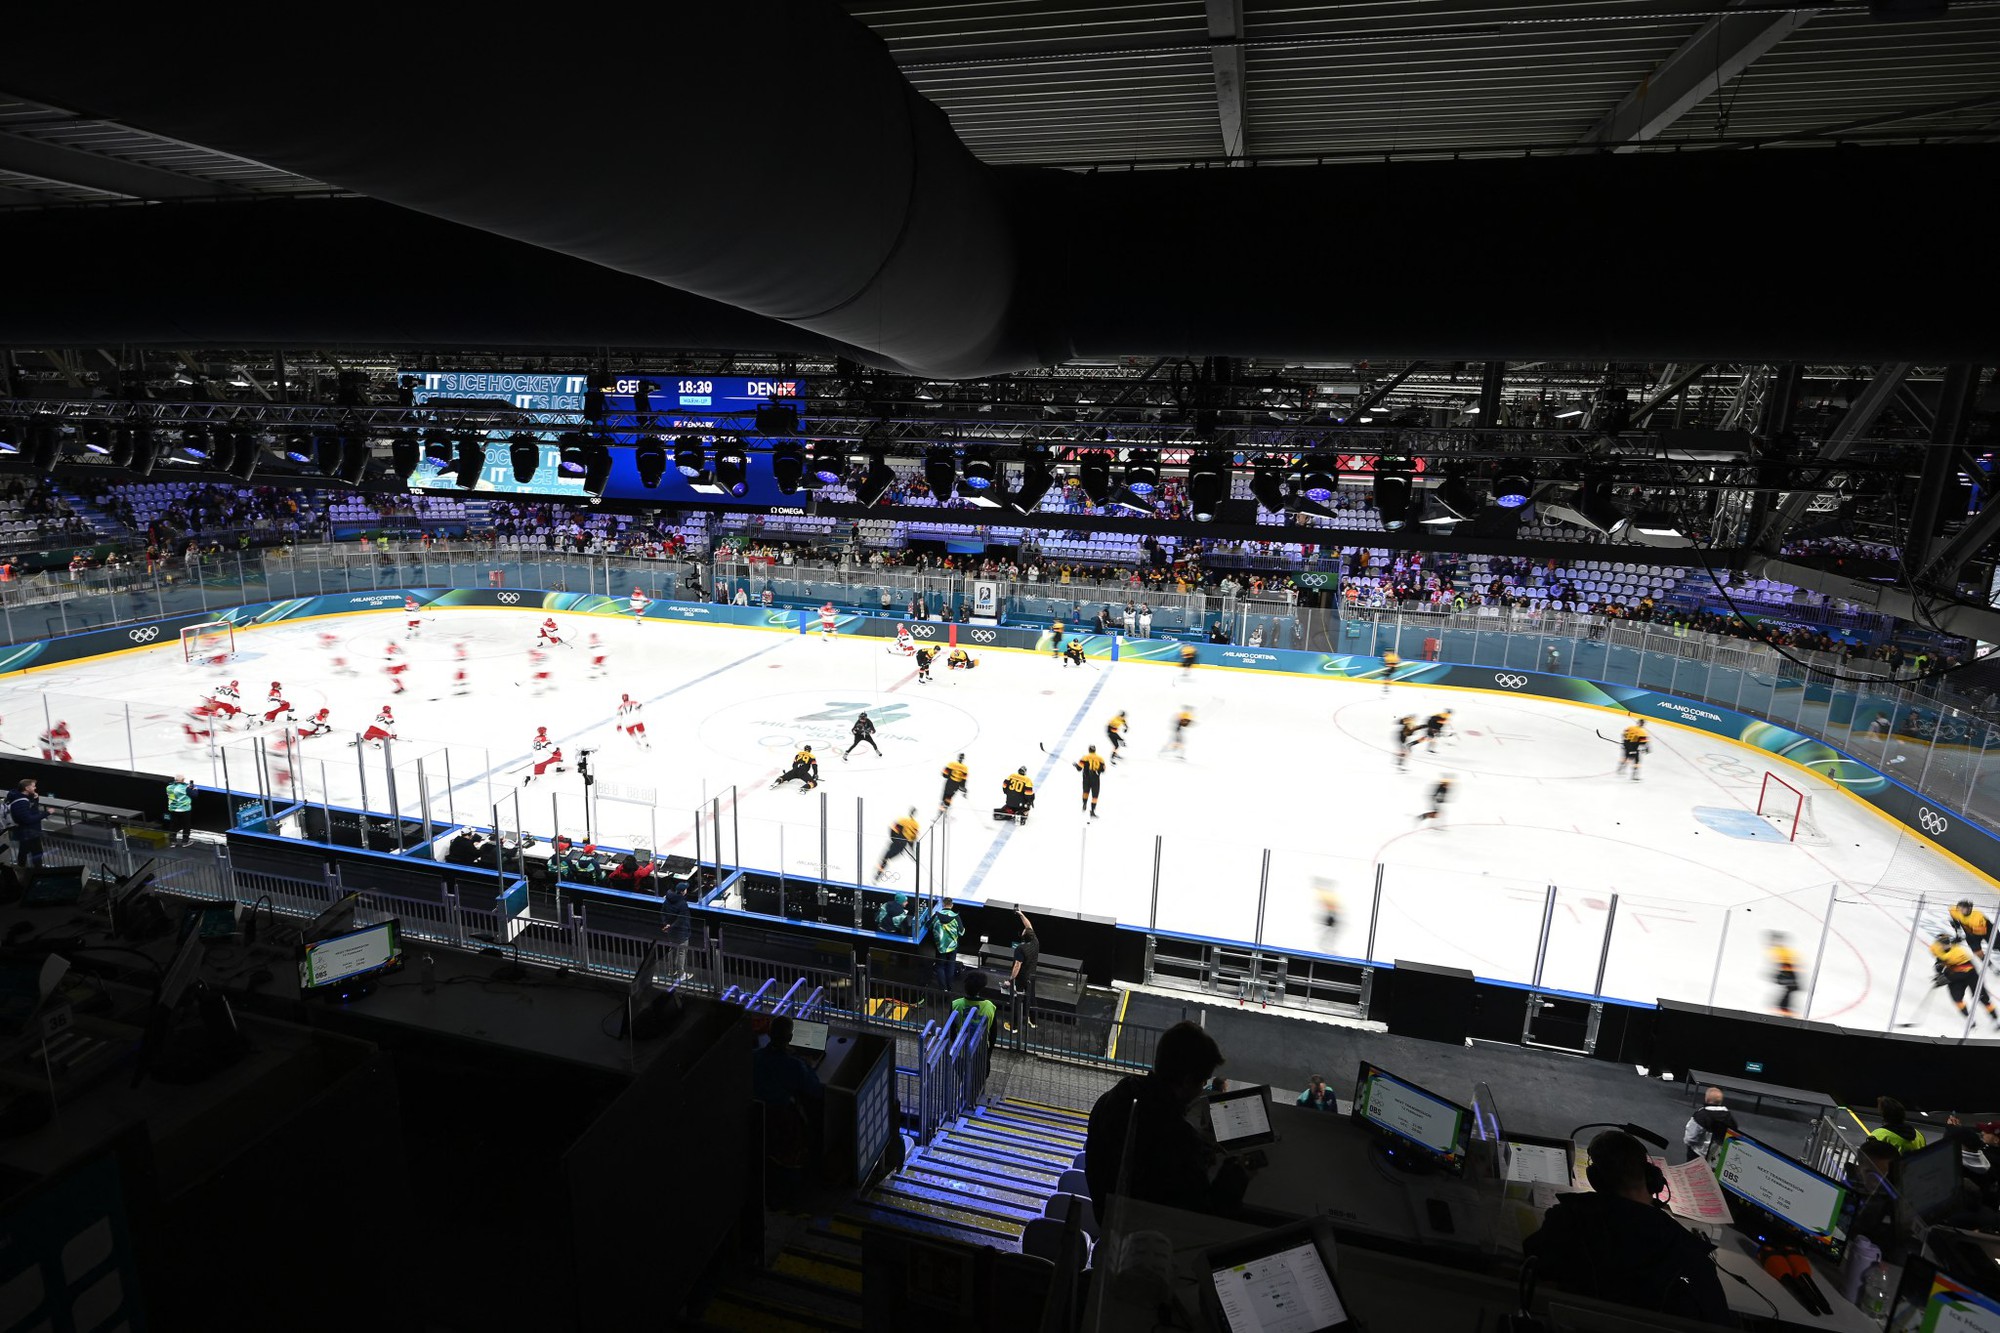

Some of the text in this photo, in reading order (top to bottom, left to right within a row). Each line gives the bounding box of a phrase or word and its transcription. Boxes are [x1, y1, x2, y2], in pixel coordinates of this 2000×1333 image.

[425, 374, 457, 391] IT'S
[459, 375, 485, 391] ICE
[488, 375, 562, 393] HOCKEY
[747, 381, 777, 396] DEN
[778, 507, 804, 515] OMEGA
[1757, 618, 1785, 627] MILANO
[1249, 653, 1277, 661] CORTINA
[1657, 701, 1722, 722] MILANO CORTINA
[1681, 712, 1697, 721] 2026
[749, 720, 919, 743] MILANO CTINA
[806, 732, 846, 740] 2026
[1009, 778, 1024, 793] 30
[1369, 1104, 1382, 1116] OBS
[1723, 1169, 1739, 1183] OBS
[1757, 1165, 1805, 1193] NEXT TRANSMISSION
